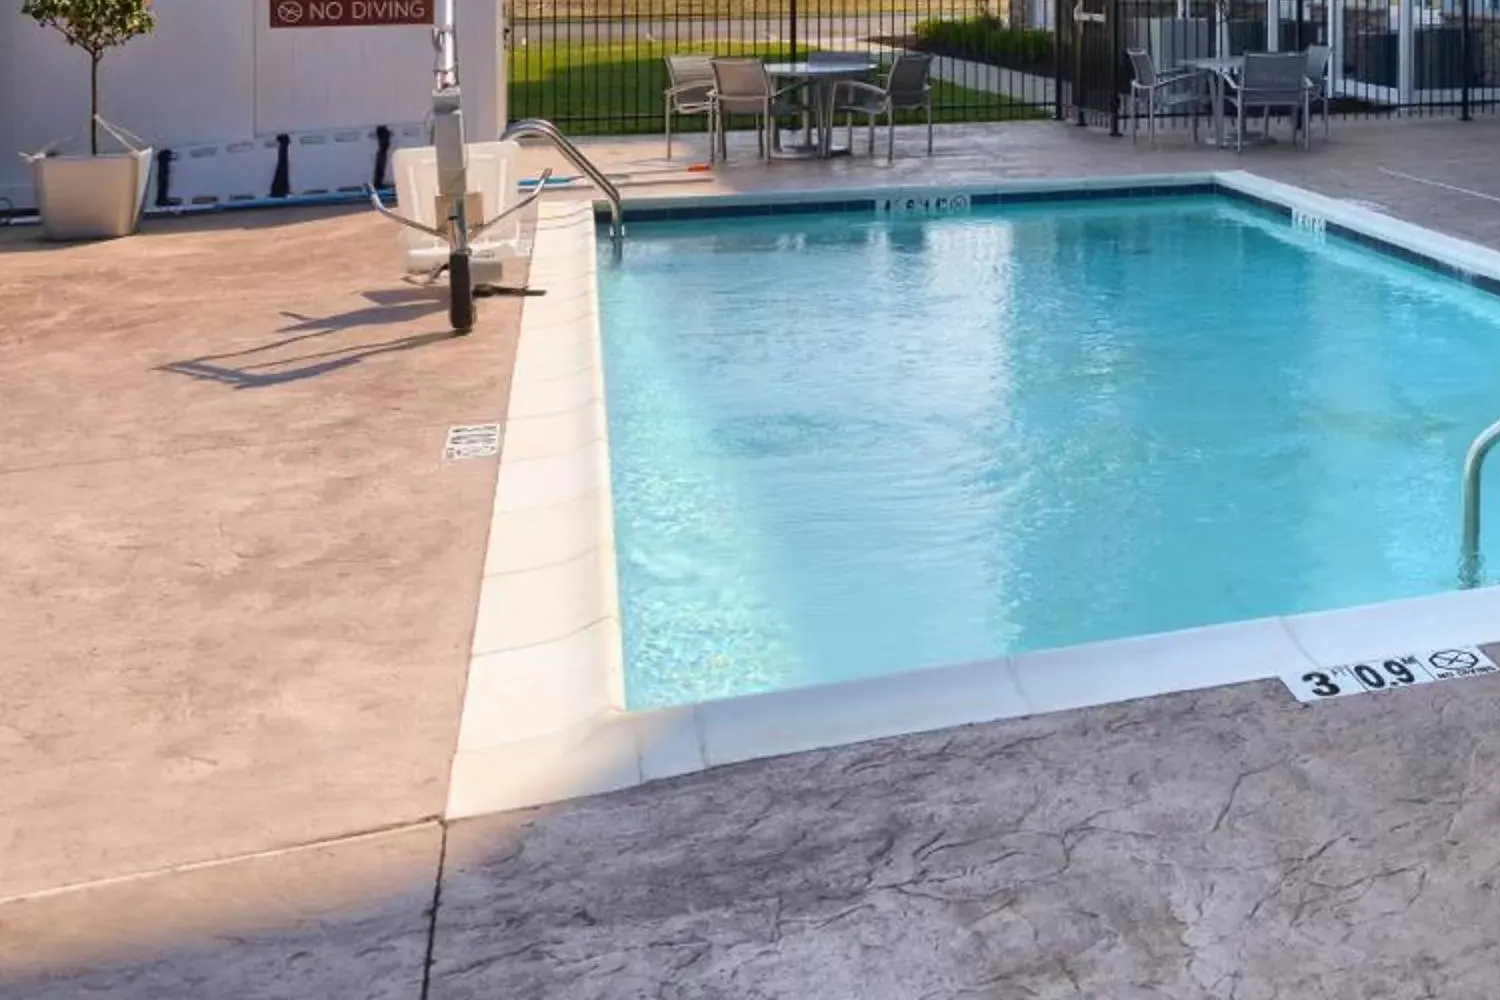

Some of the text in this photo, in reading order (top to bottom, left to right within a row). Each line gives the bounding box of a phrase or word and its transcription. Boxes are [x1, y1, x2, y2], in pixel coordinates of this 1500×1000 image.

[308, 1, 425, 20] NO DIVING
[1302, 671, 1341, 697] 3
[1354, 660, 1415, 688] 0.9
